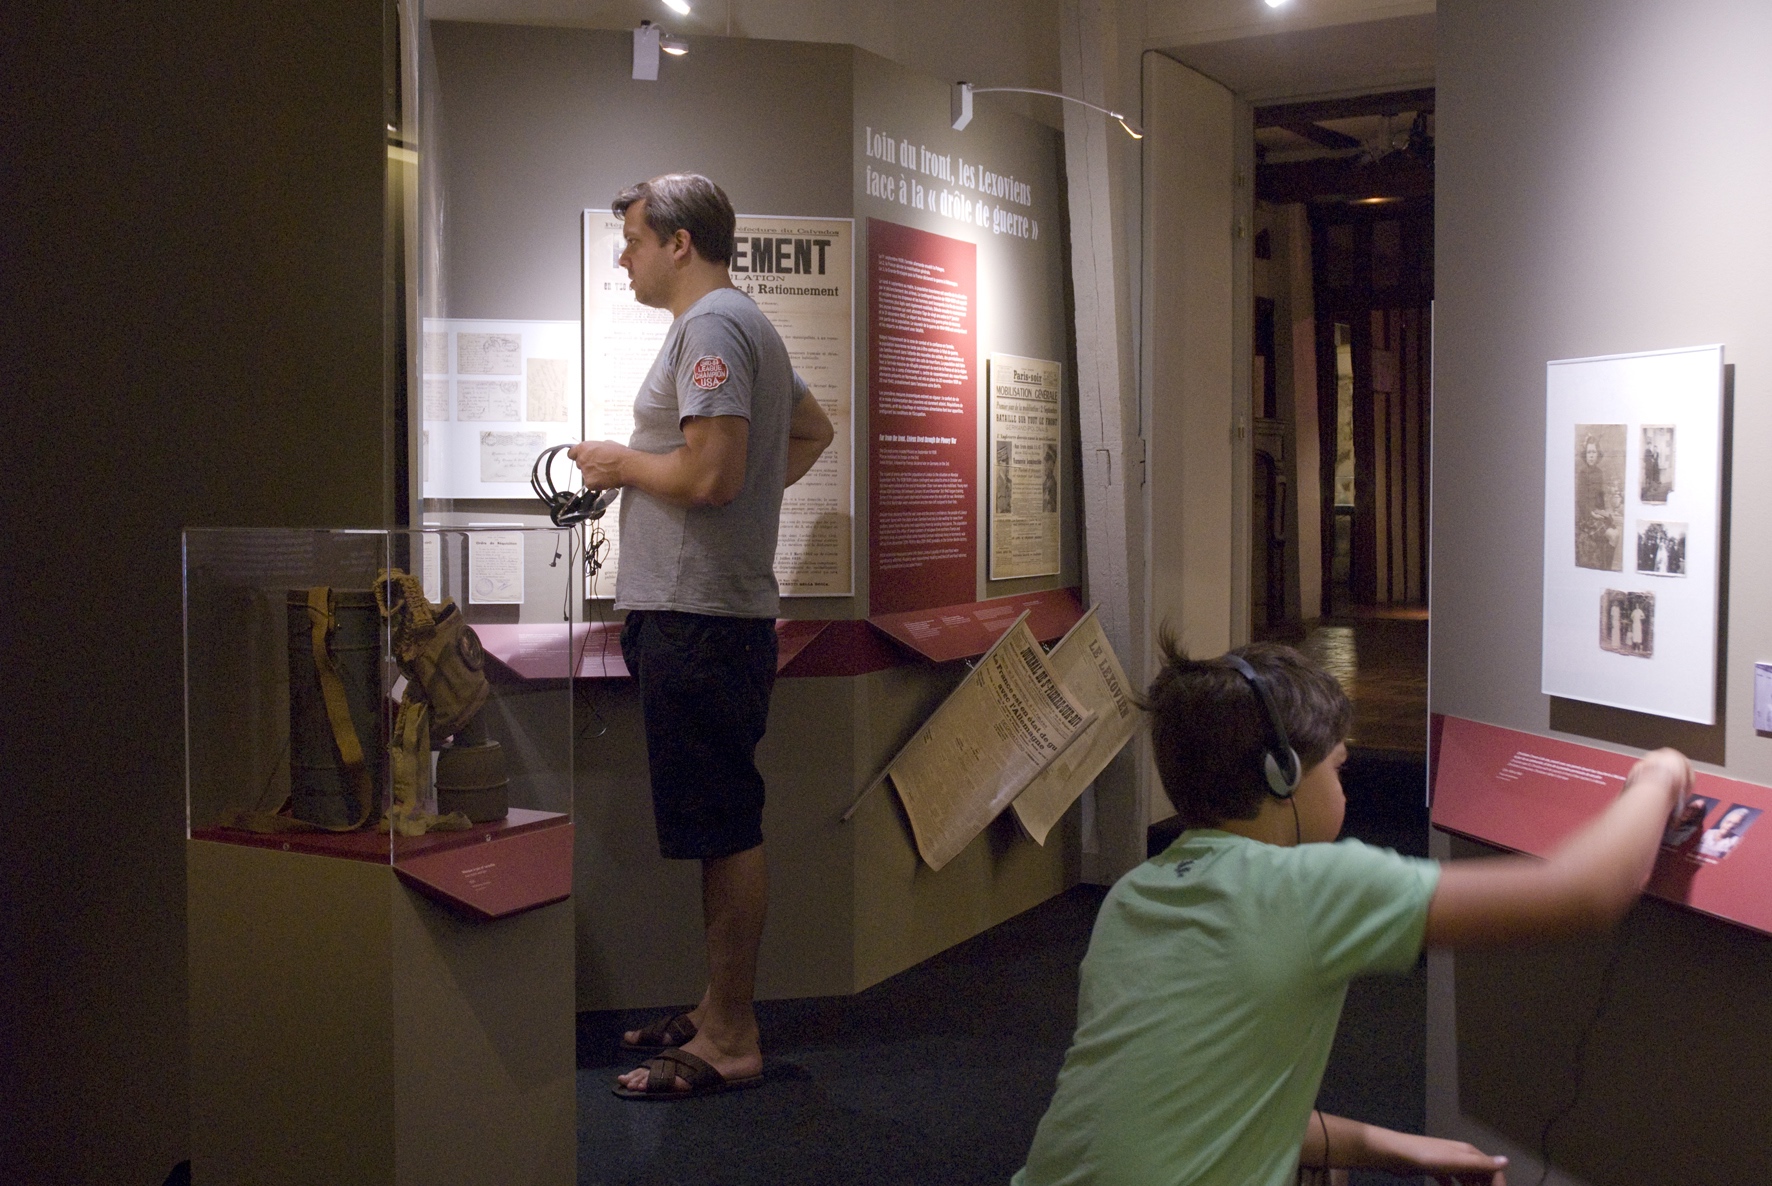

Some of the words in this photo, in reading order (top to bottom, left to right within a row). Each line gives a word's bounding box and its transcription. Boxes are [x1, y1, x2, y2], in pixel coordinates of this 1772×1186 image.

[866, 126, 896, 164] Loin
[900, 139, 916, 170] du
[920, 145, 954, 186] front,
[958, 158, 975, 188] les
[978, 165, 1032, 206] Lexoviens
[866, 165, 894, 200] face
[900, 174, 908, 205] à
[912, 179, 924, 210] la
[940, 189, 972, 223] drôle
[976, 200, 990, 228] de
[992, 204, 1028, 238] guerre
[734, 226, 777, 234] réfecture
[731, 236, 832, 275] EMENT
[758, 284, 839, 296] Rationnement
[694, 371, 726, 379] CHAMPION
[700, 376, 720, 386] USA
[1013, 370, 1042, 382] Paris-soir
[996, 386, 1032, 398] MOBILISATION
[996, 414, 1016, 423] BATAILLE
[1088, 639, 1103, 660] LE
[992, 653, 998, 665] La
[996, 664, 1013, 693] France
[1011, 693, 1023, 706] est
[1019, 706, 1028, 717] en
[1027, 715, 1041, 733] état
[1038, 731, 1048, 742] de
[997, 684, 1010, 702] avec
[1009, 703, 1044, 749] l'Allemagne
